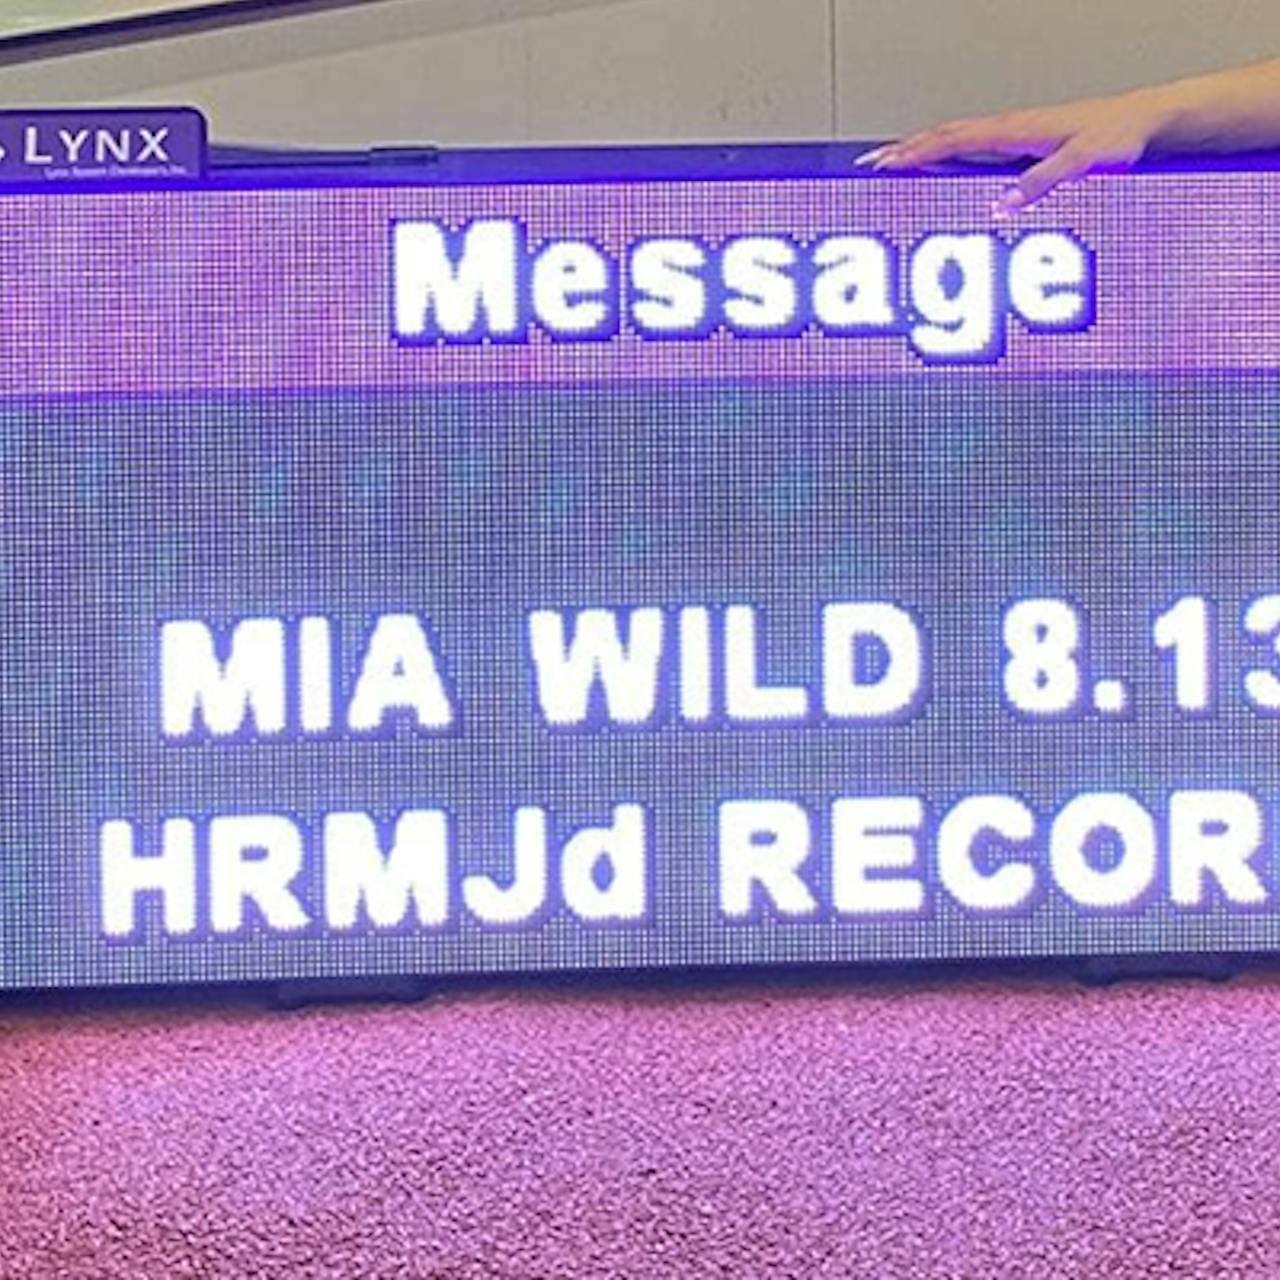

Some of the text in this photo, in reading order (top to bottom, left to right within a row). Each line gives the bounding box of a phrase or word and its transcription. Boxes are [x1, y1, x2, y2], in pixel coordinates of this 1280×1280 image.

[24, 126, 169, 164] LYNX
[391, 218, 1094, 362] Message
[160, 612, 453, 738] MIA
[528, 599, 922, 726] WILD
[99, 803, 647, 937] HRMJd
